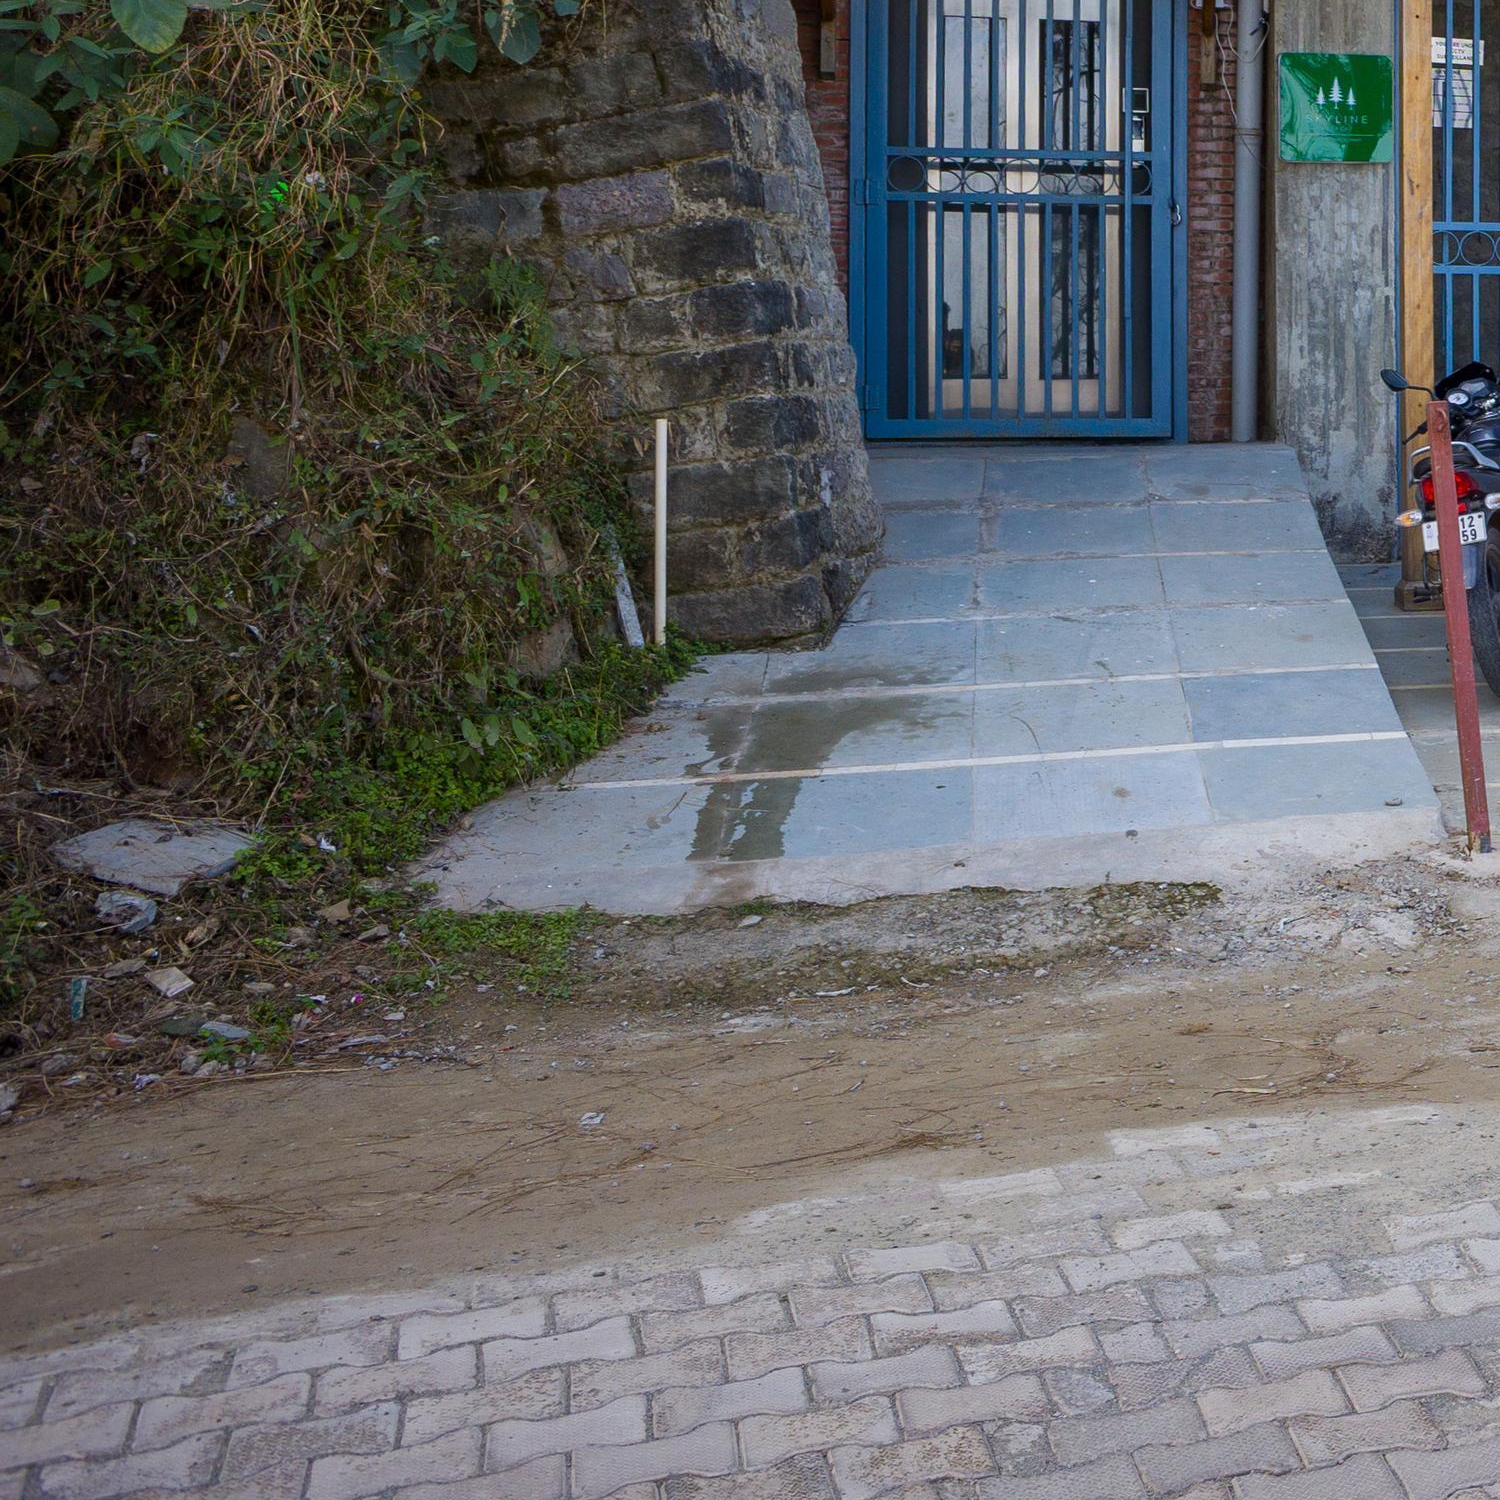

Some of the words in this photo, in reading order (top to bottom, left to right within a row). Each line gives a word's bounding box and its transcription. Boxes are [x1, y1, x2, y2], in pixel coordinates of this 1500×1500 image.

[1305, 114, 1369, 125] SKYLINE
[1460, 515, 1475, 529] 12
[1461, 528, 1477, 542] 59
